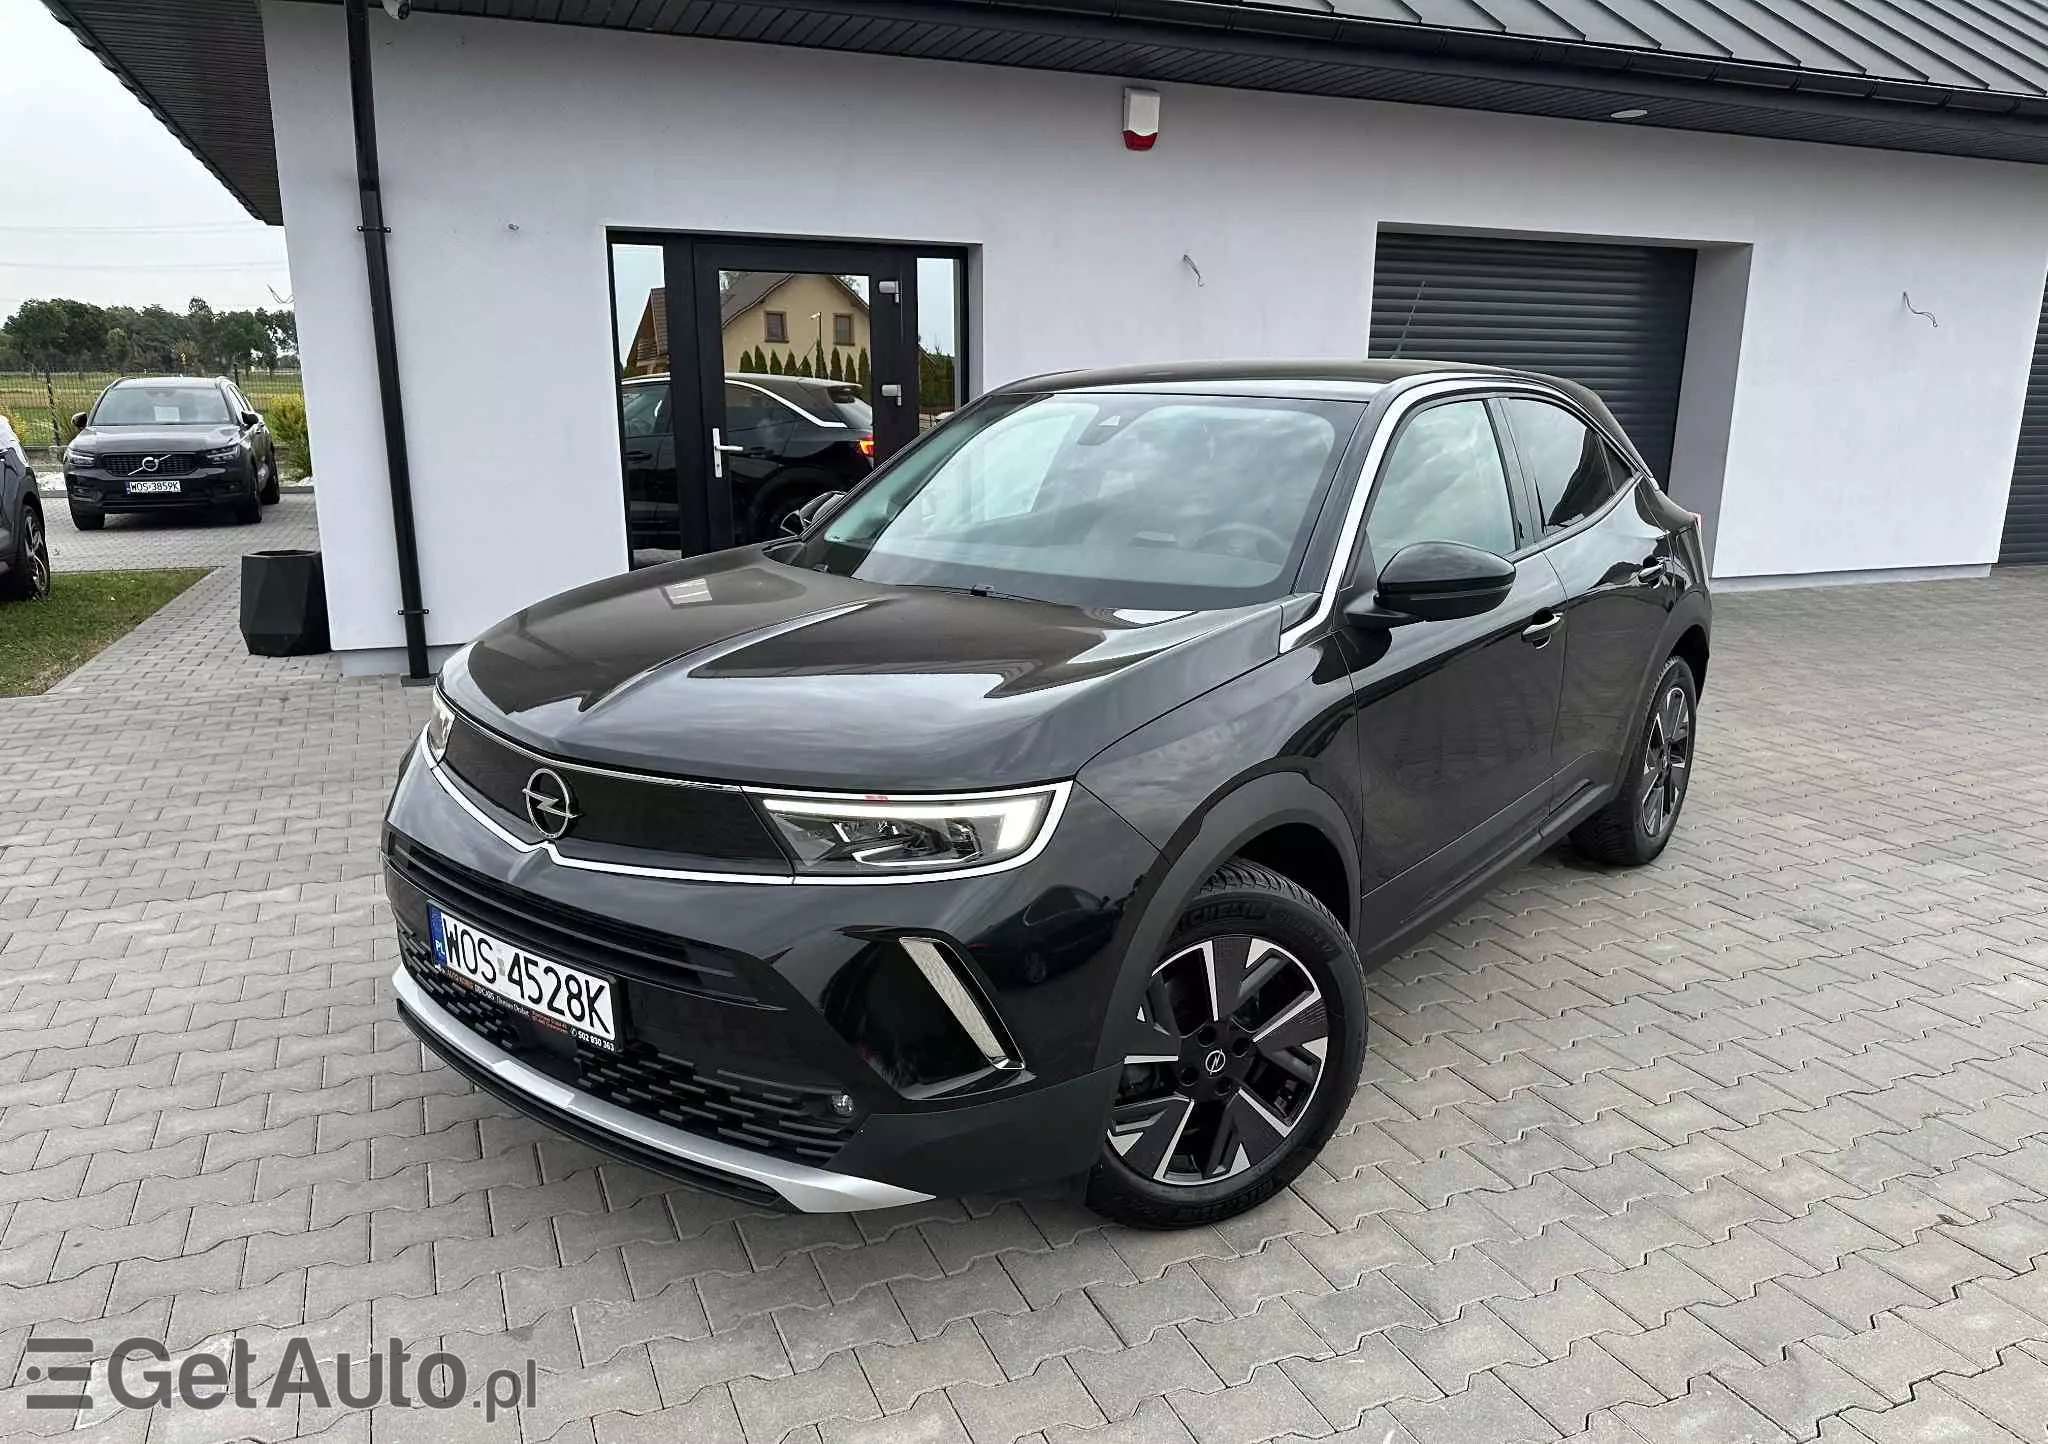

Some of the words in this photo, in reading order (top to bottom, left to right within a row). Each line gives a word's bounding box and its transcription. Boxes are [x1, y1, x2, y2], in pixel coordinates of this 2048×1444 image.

[130, 482, 149, 491] WOS
[152, 481, 179, 491] 3859K
[434, 939, 446, 956] PL
[444, 917, 497, 984] WOS
[507, 952, 611, 1035] 4528K
